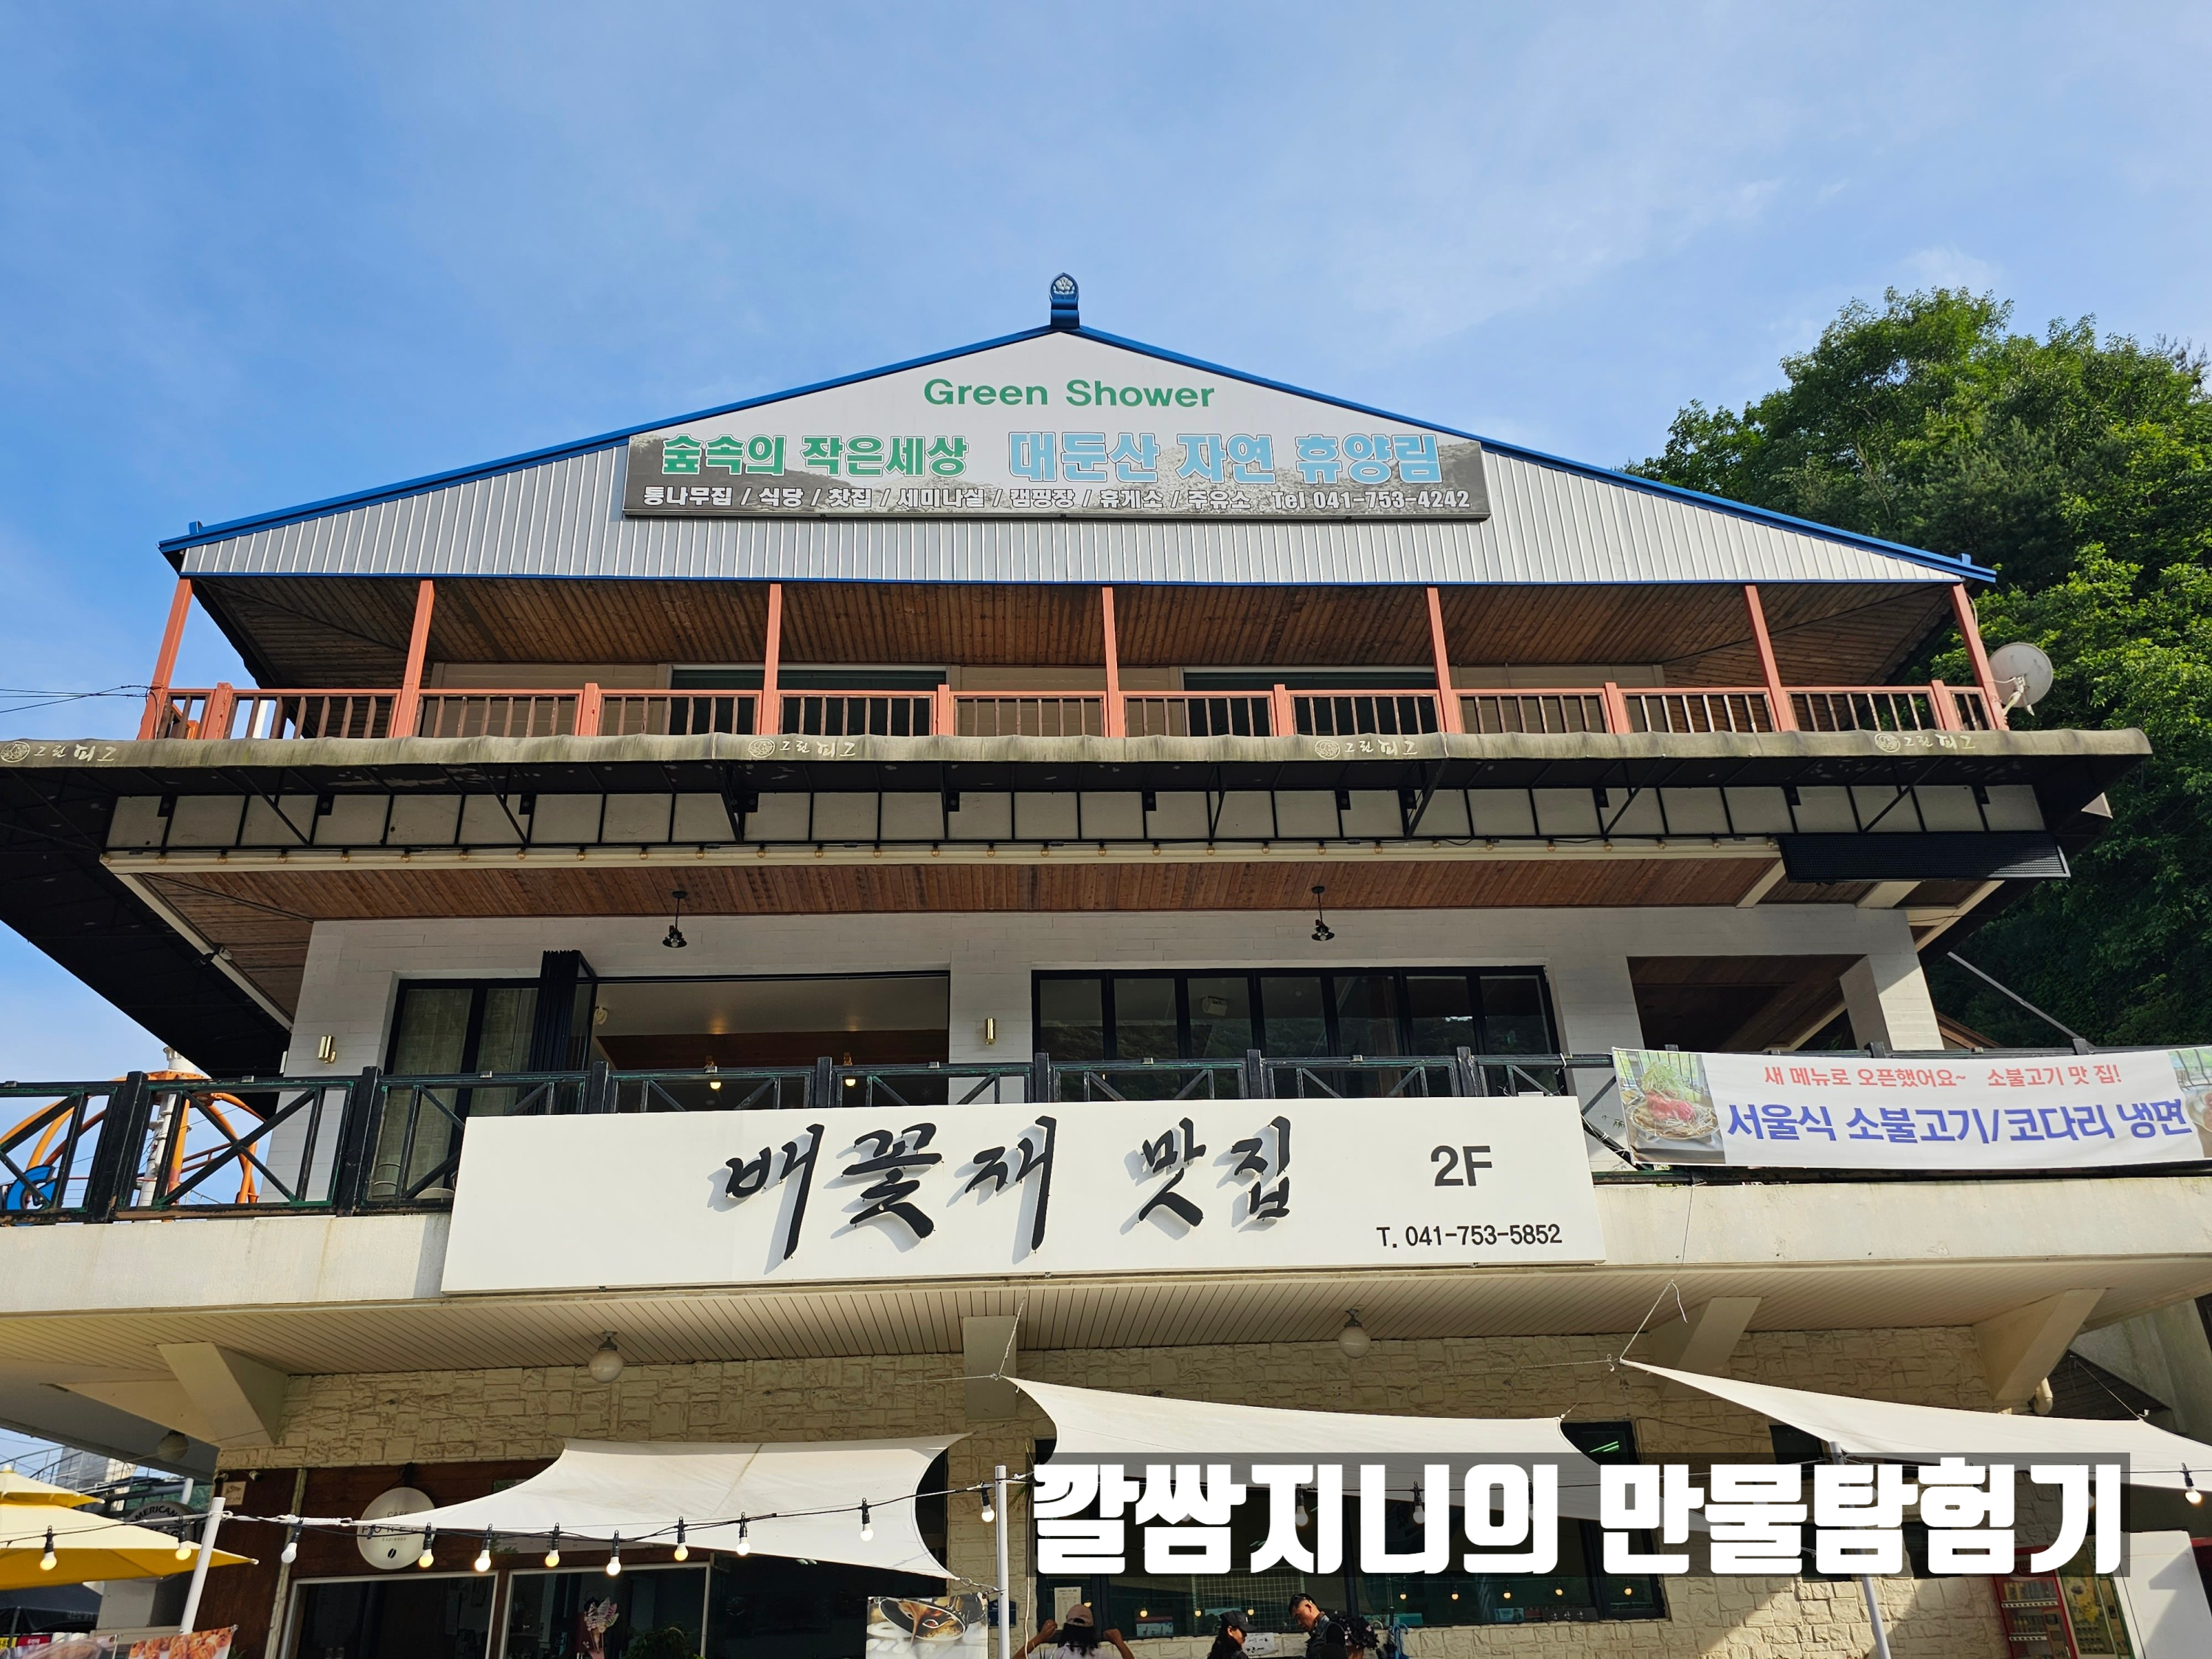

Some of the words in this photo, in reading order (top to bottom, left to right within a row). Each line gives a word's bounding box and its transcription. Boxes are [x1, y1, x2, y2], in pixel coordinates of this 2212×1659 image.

[924, 379, 1048, 406] Green
[1066, 379, 1215, 407] Shower
[662, 434, 787, 476] 숲속의
[801, 436, 970, 478] 작은세상
[1009, 432, 1160, 482] 대둔산
[1177, 434, 1276, 484] 자연
[1295, 434, 1442, 484] 휴양림
[643, 486, 733, 507] 통나무집
[759, 487, 804, 507] 식당
[827, 487, 872, 508] 찻집
[897, 488, 985, 508] 세미나실
[1009, 489, 1075, 509] 캠핑장
[1099, 489, 1164, 509] 휴게소
[1187, 490, 1252, 509] 주유소
[1272, 491, 1306, 509] Tel
[1312, 490, 1470, 509] 041-753-4242
[1764, 1066, 1784, 1085] 새
[1789, 1067, 1849, 1086] 메뉴로
[1857, 1068, 1966, 1088] 오픈했어요~
[1988, 1067, 2064, 1088] 소불고기
[2068, 1065, 2090, 1085] 맛
[1728, 1104, 1836, 1142] 서울식
[1846, 1104, 2115, 1144] 소불고기/코다리
[2116, 1098, 2193, 1140] 냉면
[1430, 1145, 1492, 1187] 2F
[725, 1116, 1057, 1260] 배꽃재
[1138, 1116, 1291, 1228] 맛집
[1405, 1223, 1563, 1247] 041-753-5852
